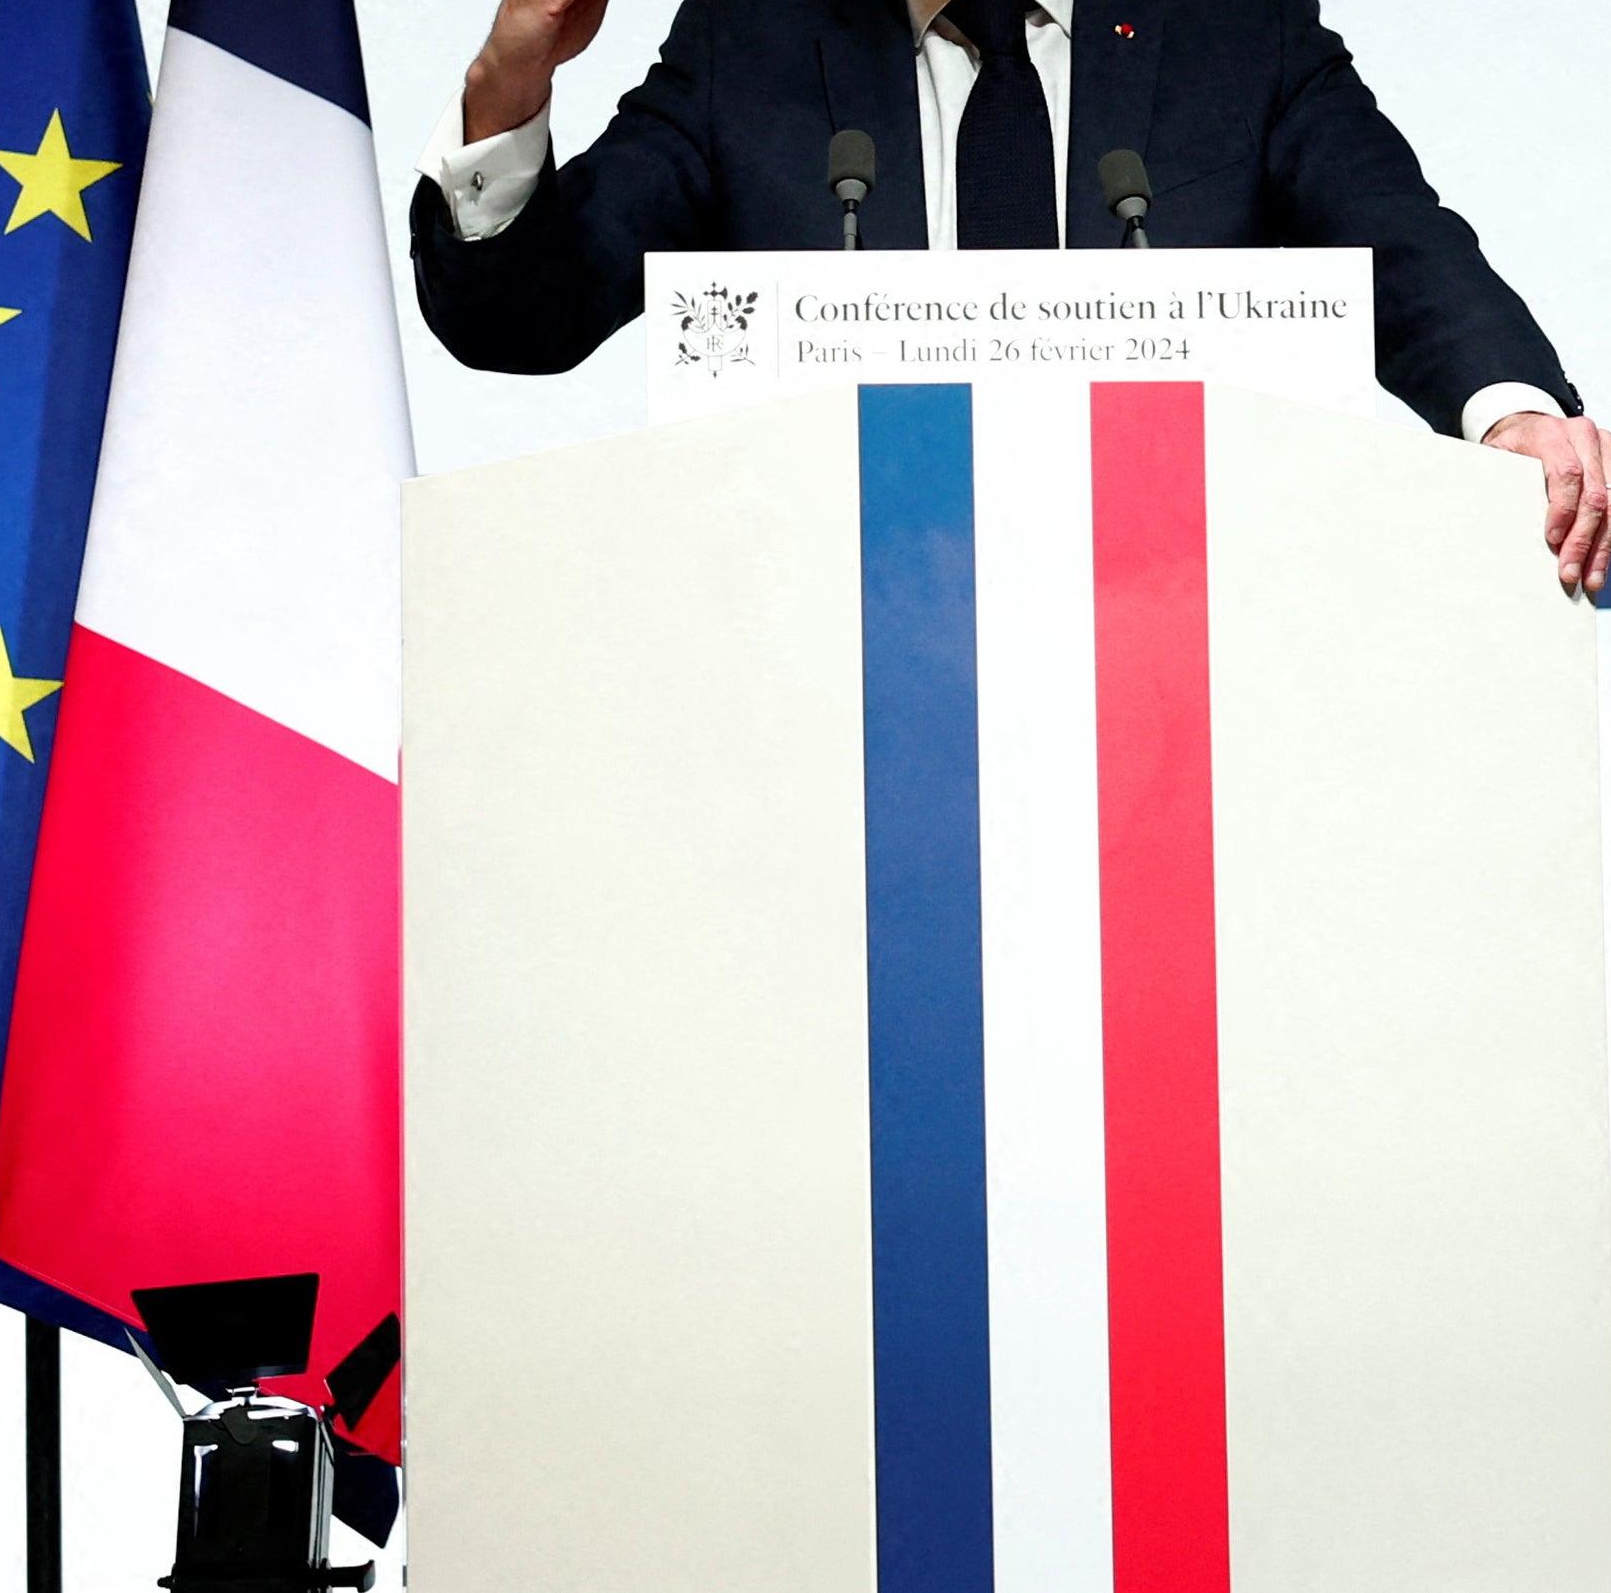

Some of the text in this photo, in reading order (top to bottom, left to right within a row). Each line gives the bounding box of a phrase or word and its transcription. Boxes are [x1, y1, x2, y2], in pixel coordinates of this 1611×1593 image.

[794, 292, 978, 322] Conférence
[989, 292, 1027, 321] de
[1038, 292, 1156, 321] soutien
[1169, 291, 1185, 320] à
[797, 339, 863, 364] Paris
[899, 338, 977, 363] Lundi
[989, 338, 1021, 362] 26
[1030, 337, 1116, 362] février
[1124, 337, 1191, 361] 2024
